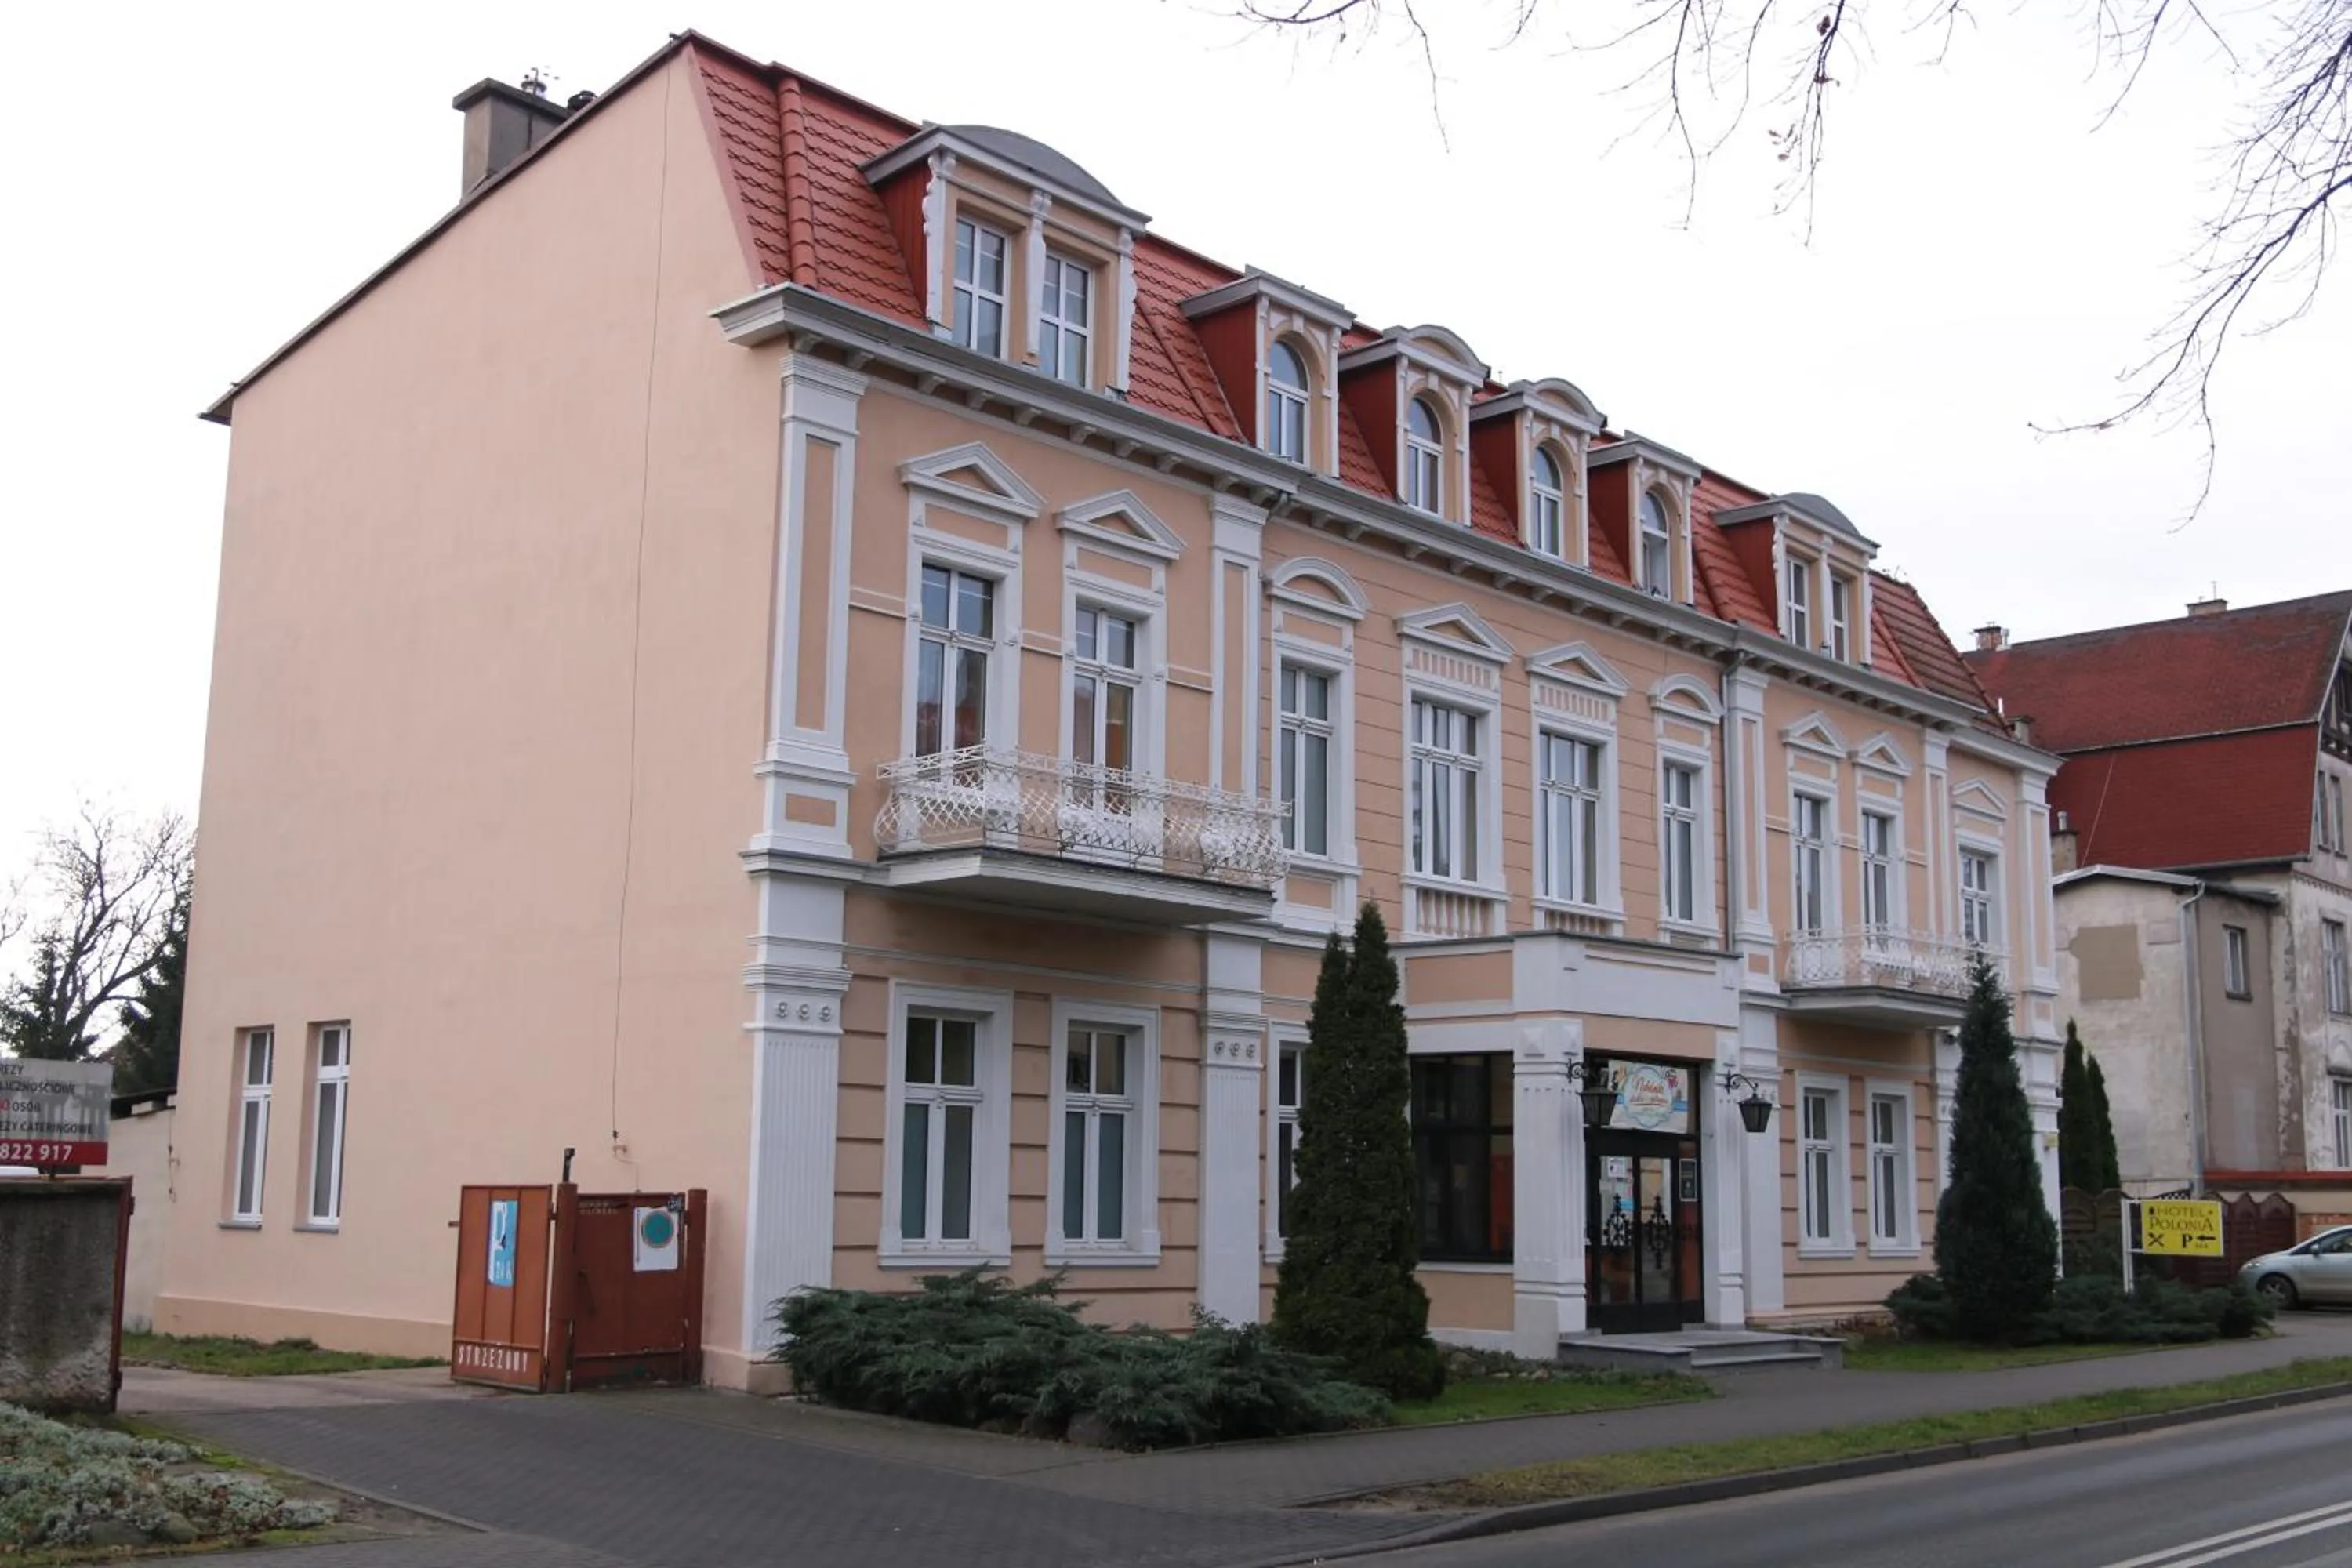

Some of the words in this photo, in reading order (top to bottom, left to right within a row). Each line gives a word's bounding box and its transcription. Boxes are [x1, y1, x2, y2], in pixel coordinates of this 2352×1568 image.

[0, 1142, 33, 1160] 822
[39, 1144, 73, 1161] 917
[2157, 1207, 2205, 1218] HOTEL
[2149, 1218, 2213, 1232] POLONIA
[2182, 1233, 2193, 1248] P
